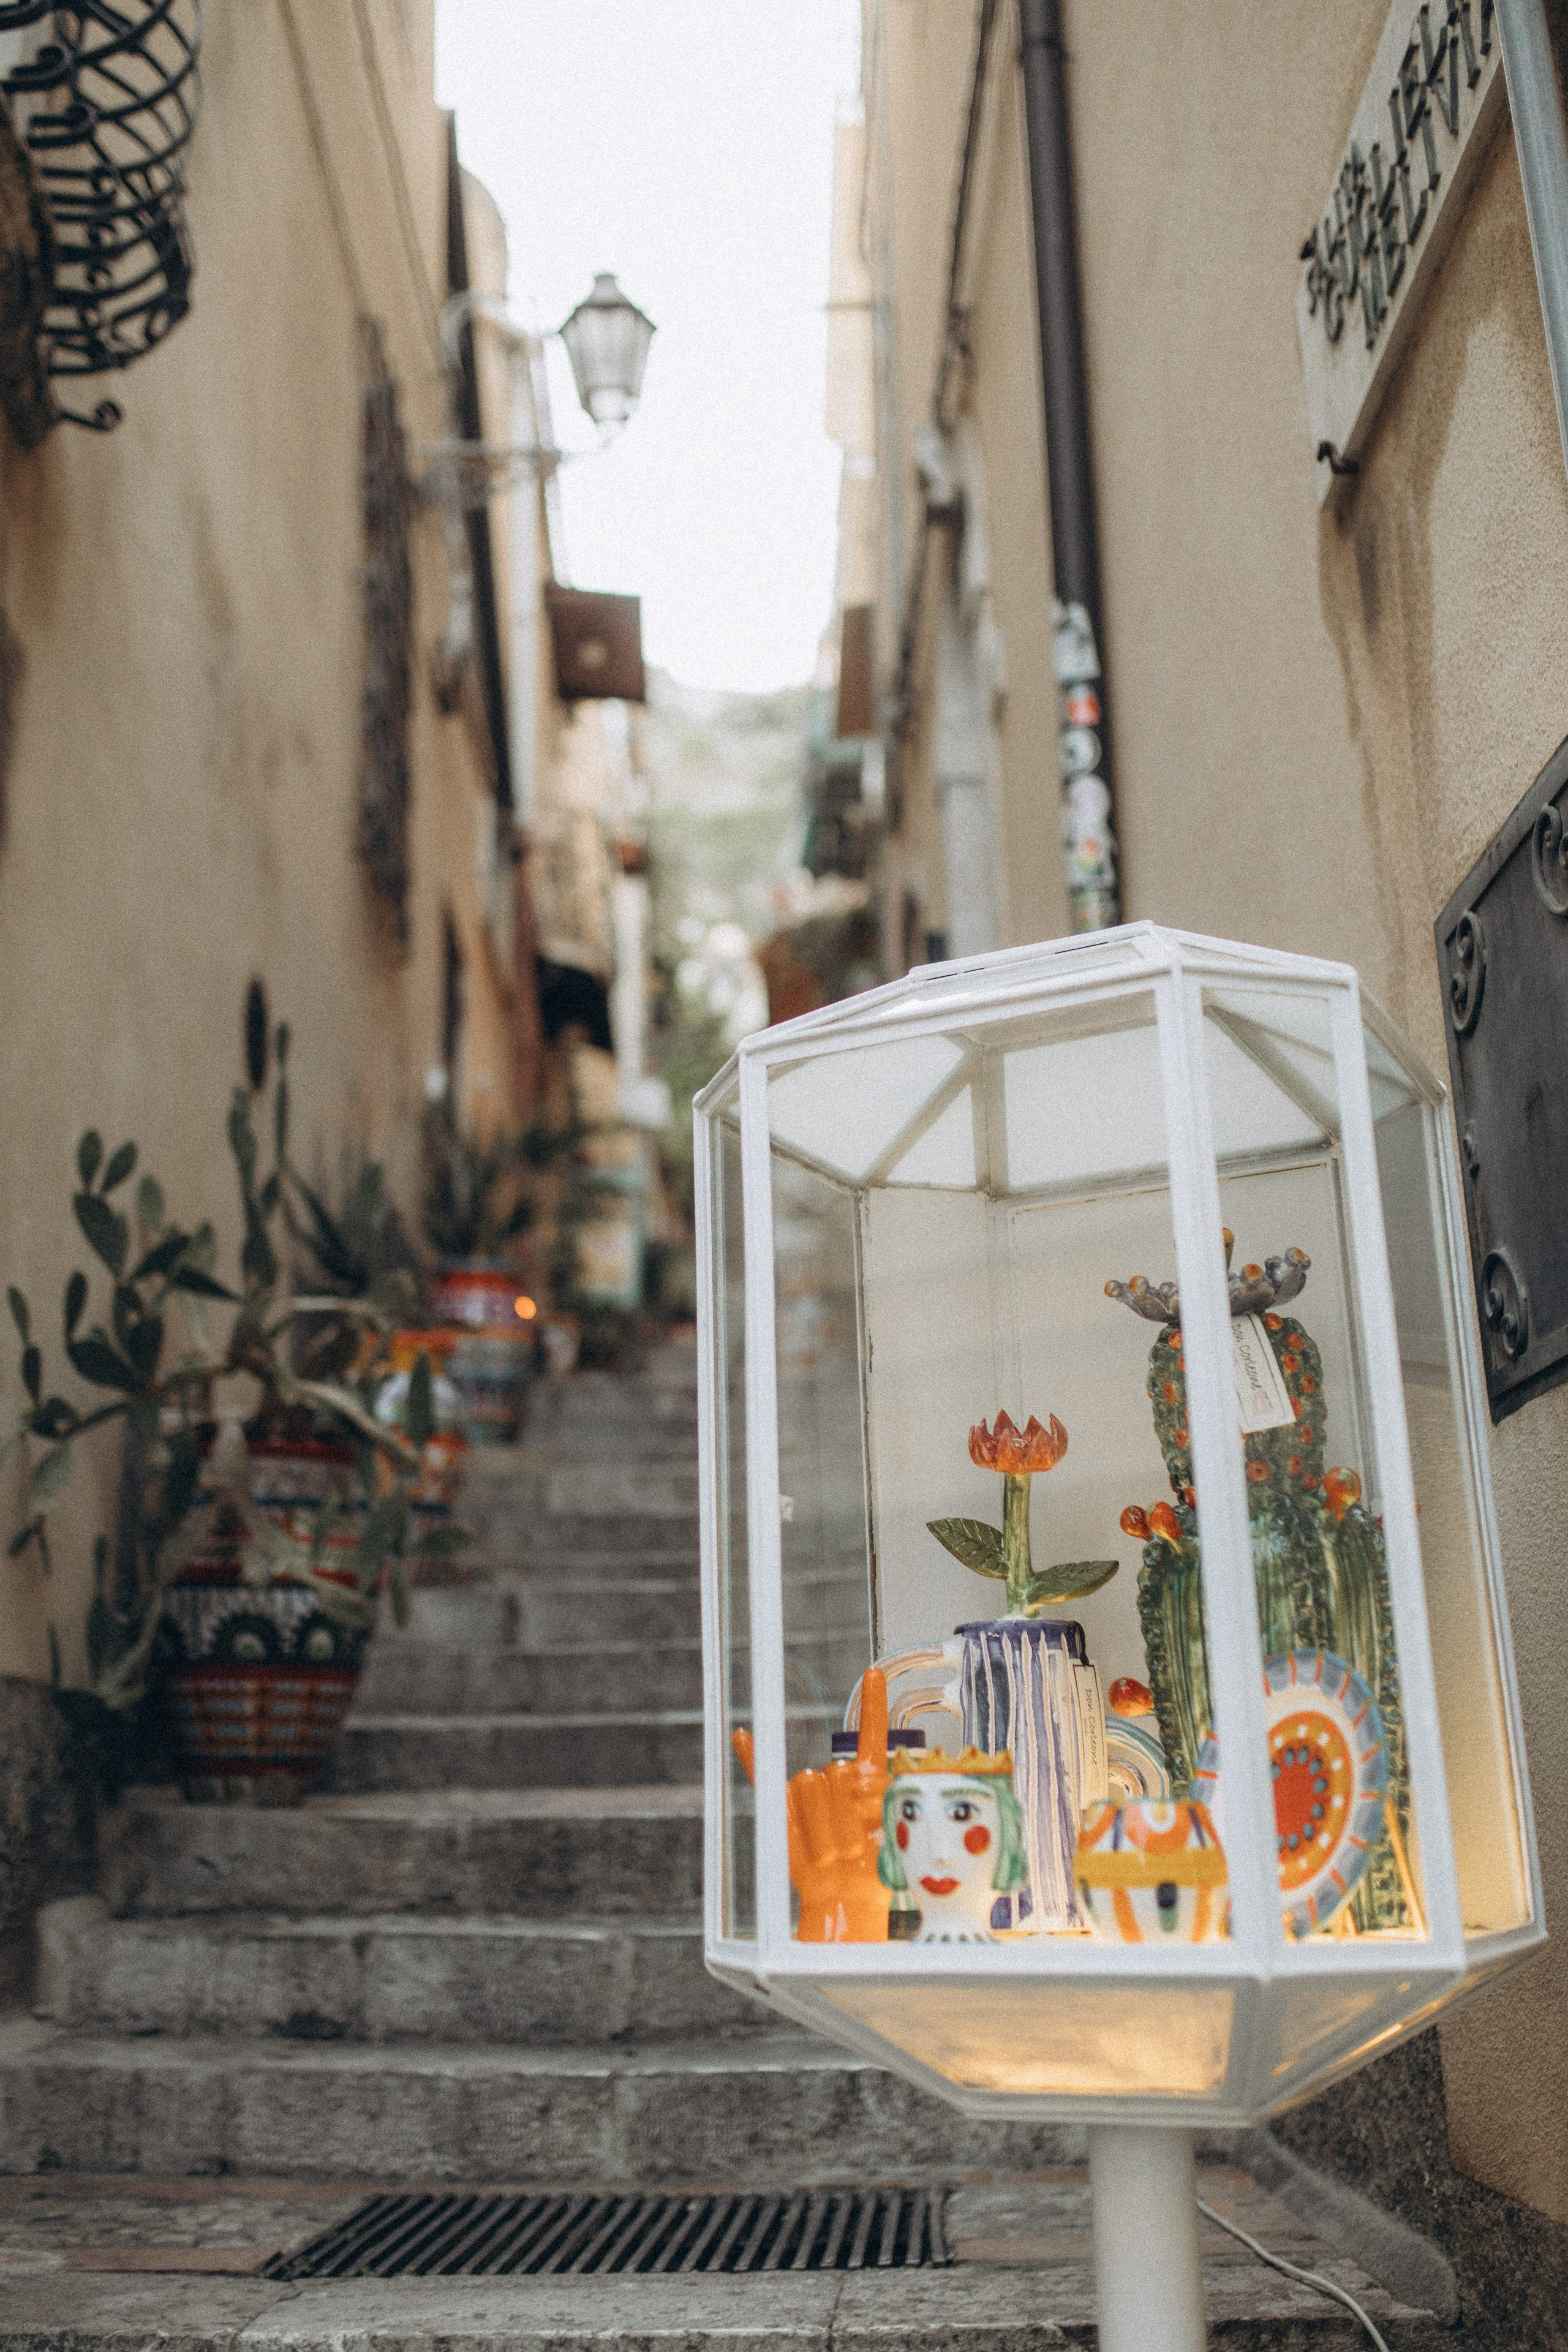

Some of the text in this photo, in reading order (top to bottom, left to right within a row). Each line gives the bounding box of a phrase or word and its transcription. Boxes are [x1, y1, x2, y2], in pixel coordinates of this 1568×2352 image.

[1231, 1323, 1262, 1390] Don Corleone
[1089, 1716, 1098, 1765] Corleone
